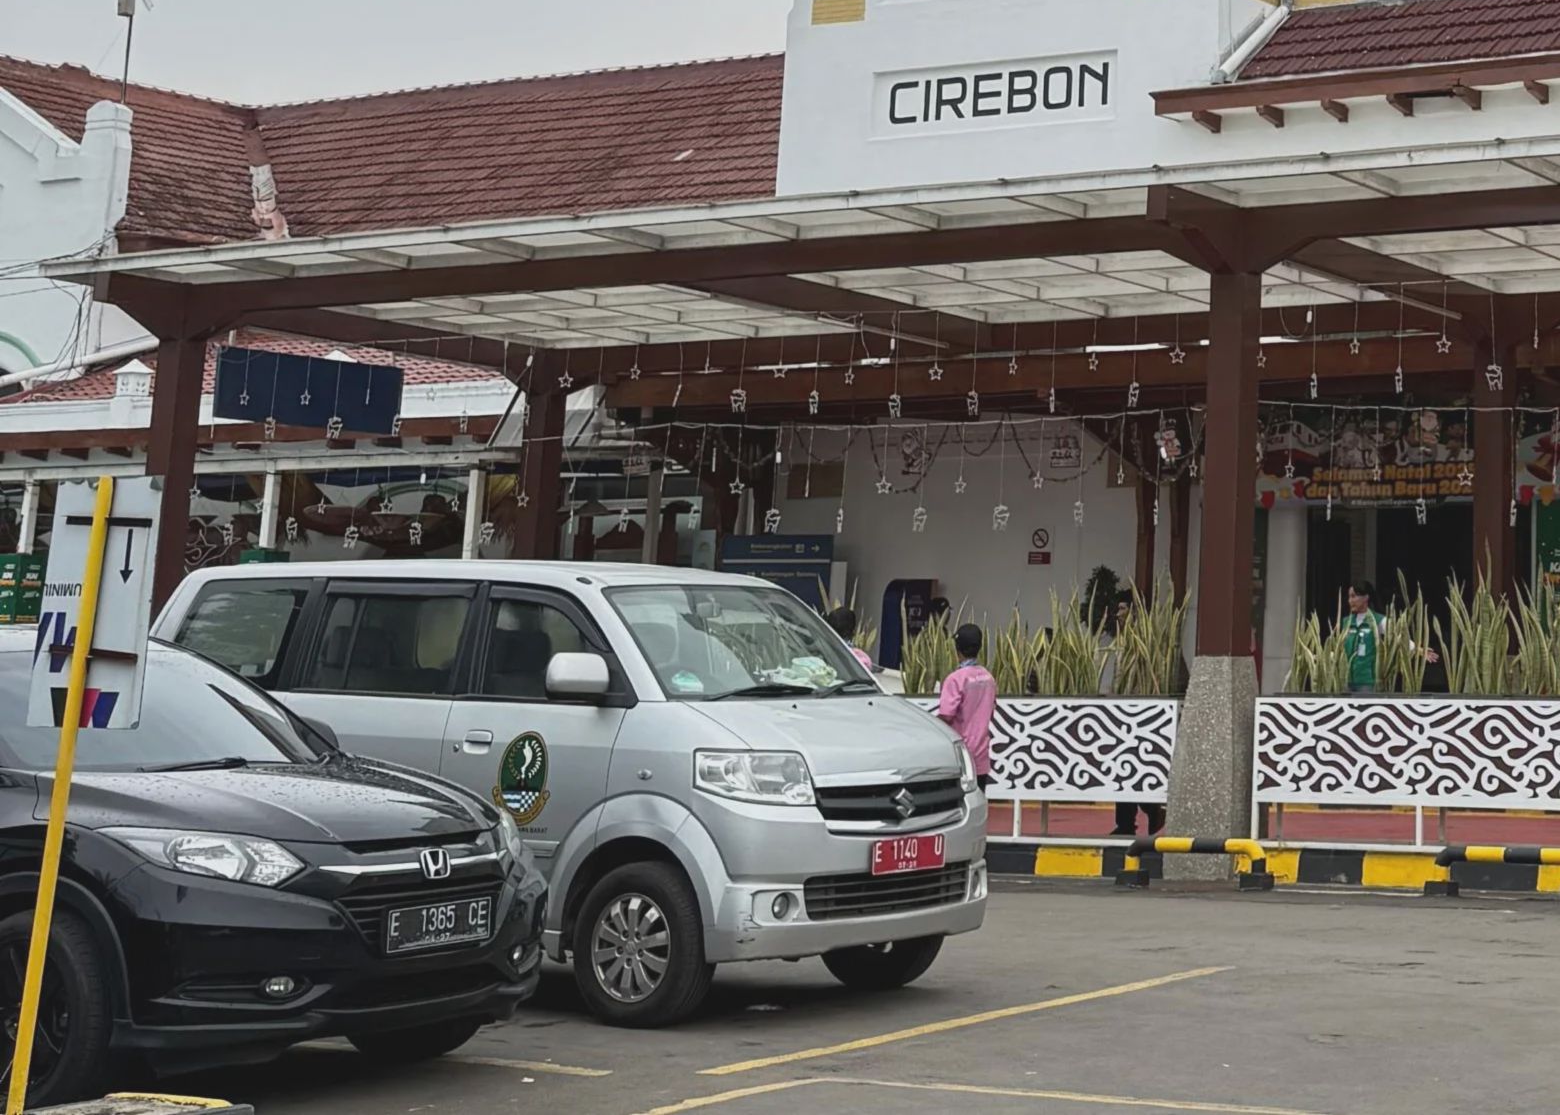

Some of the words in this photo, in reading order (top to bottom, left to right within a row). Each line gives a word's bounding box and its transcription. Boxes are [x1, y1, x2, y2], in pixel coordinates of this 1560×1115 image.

[889, 62, 1109, 124] CIREBON
[1385, 462, 1431, 480] Natal
[1305, 483, 1339, 498] dan
[1341, 481, 1392, 497] Tahun
[1394, 480, 1437, 496] Baru
[1439, 479, 1474, 495] 202
[875, 842, 882, 863] E
[893, 838, 918, 860] 1140
[934, 835, 943, 856] U
[390, 912, 401, 937] E
[421, 904, 456, 933] 1365
[468, 900, 488, 926] CE
